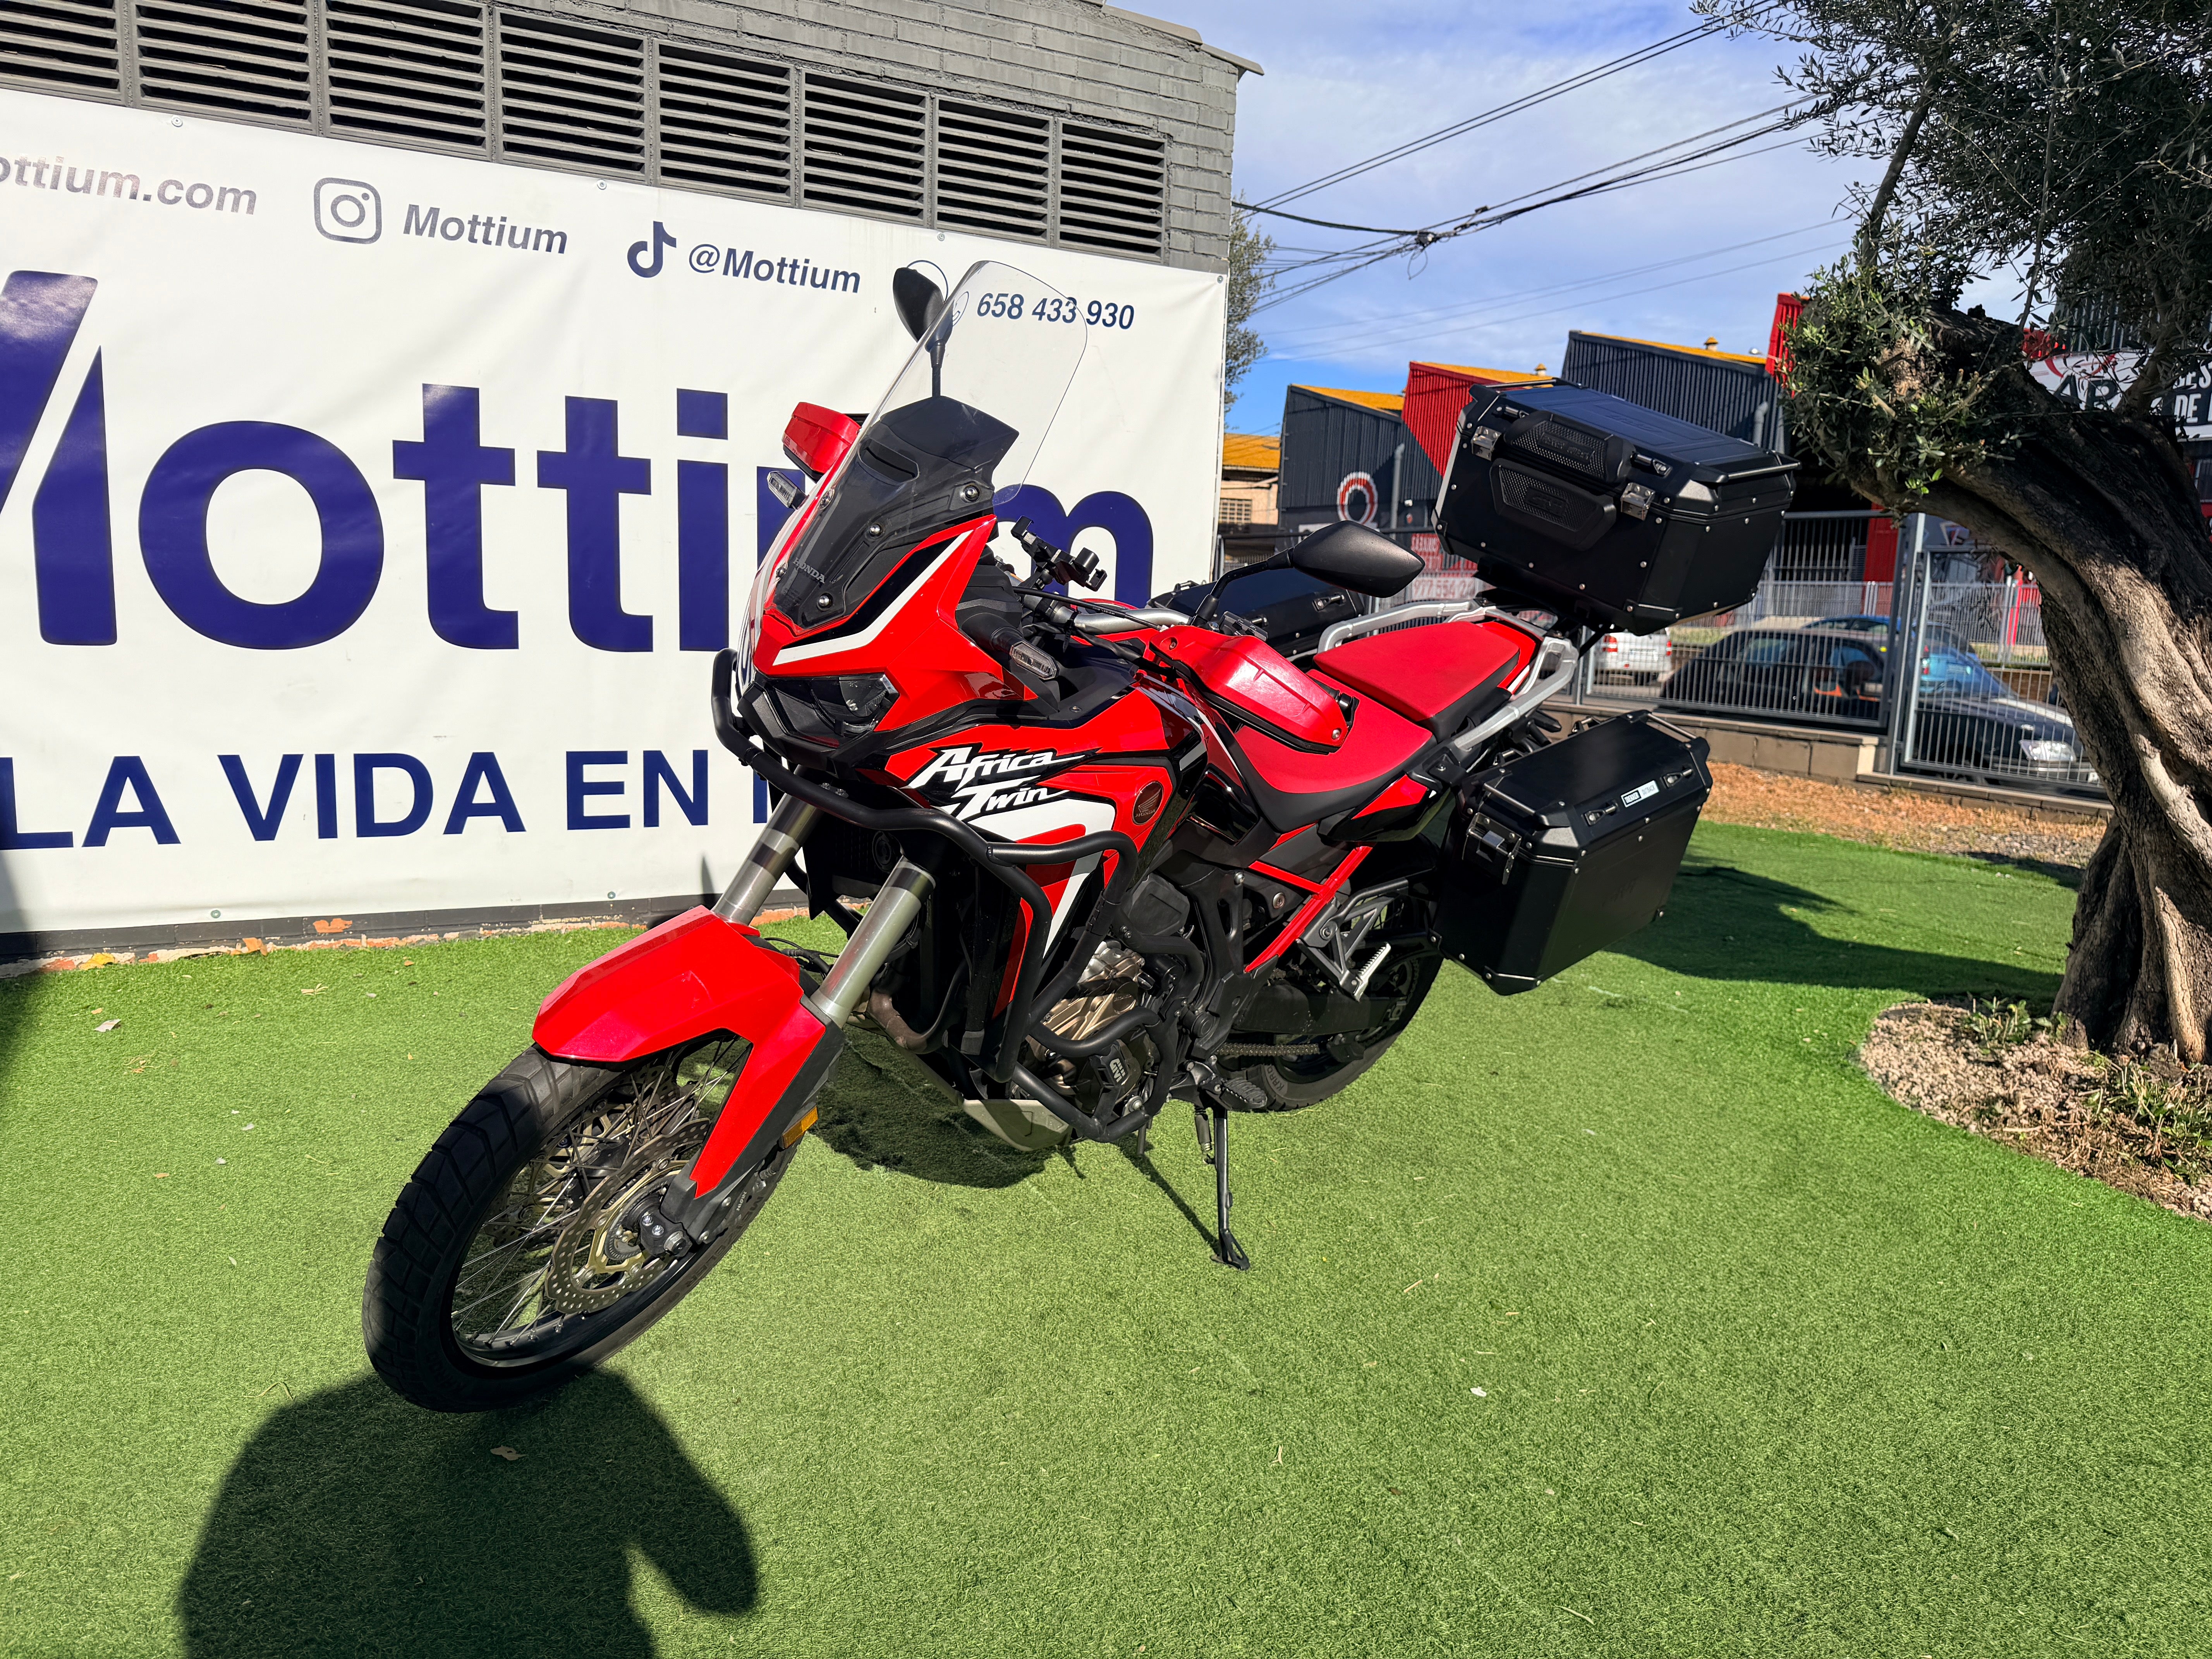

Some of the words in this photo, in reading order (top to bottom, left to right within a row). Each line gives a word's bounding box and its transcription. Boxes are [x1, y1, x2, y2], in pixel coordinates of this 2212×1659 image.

[0, 155, 257, 215] ttium.com
[403, 204, 568, 254] Mottium
[689, 244, 860, 294] @Mottium
[977, 293, 1024, 319] 658
[1031, 297, 1078, 325] 433
[1086, 300, 1134, 330] 930
[793, 558, 826, 584] HONDA
[907, 746, 1085, 792] Africa
[0, 756, 181, 849] LA
[217, 752, 526, 842] VIDA
[566, 749, 708, 831] EN
[951, 775, 1070, 821] Twin
[1109, 1058, 1126, 1083] GIVI
